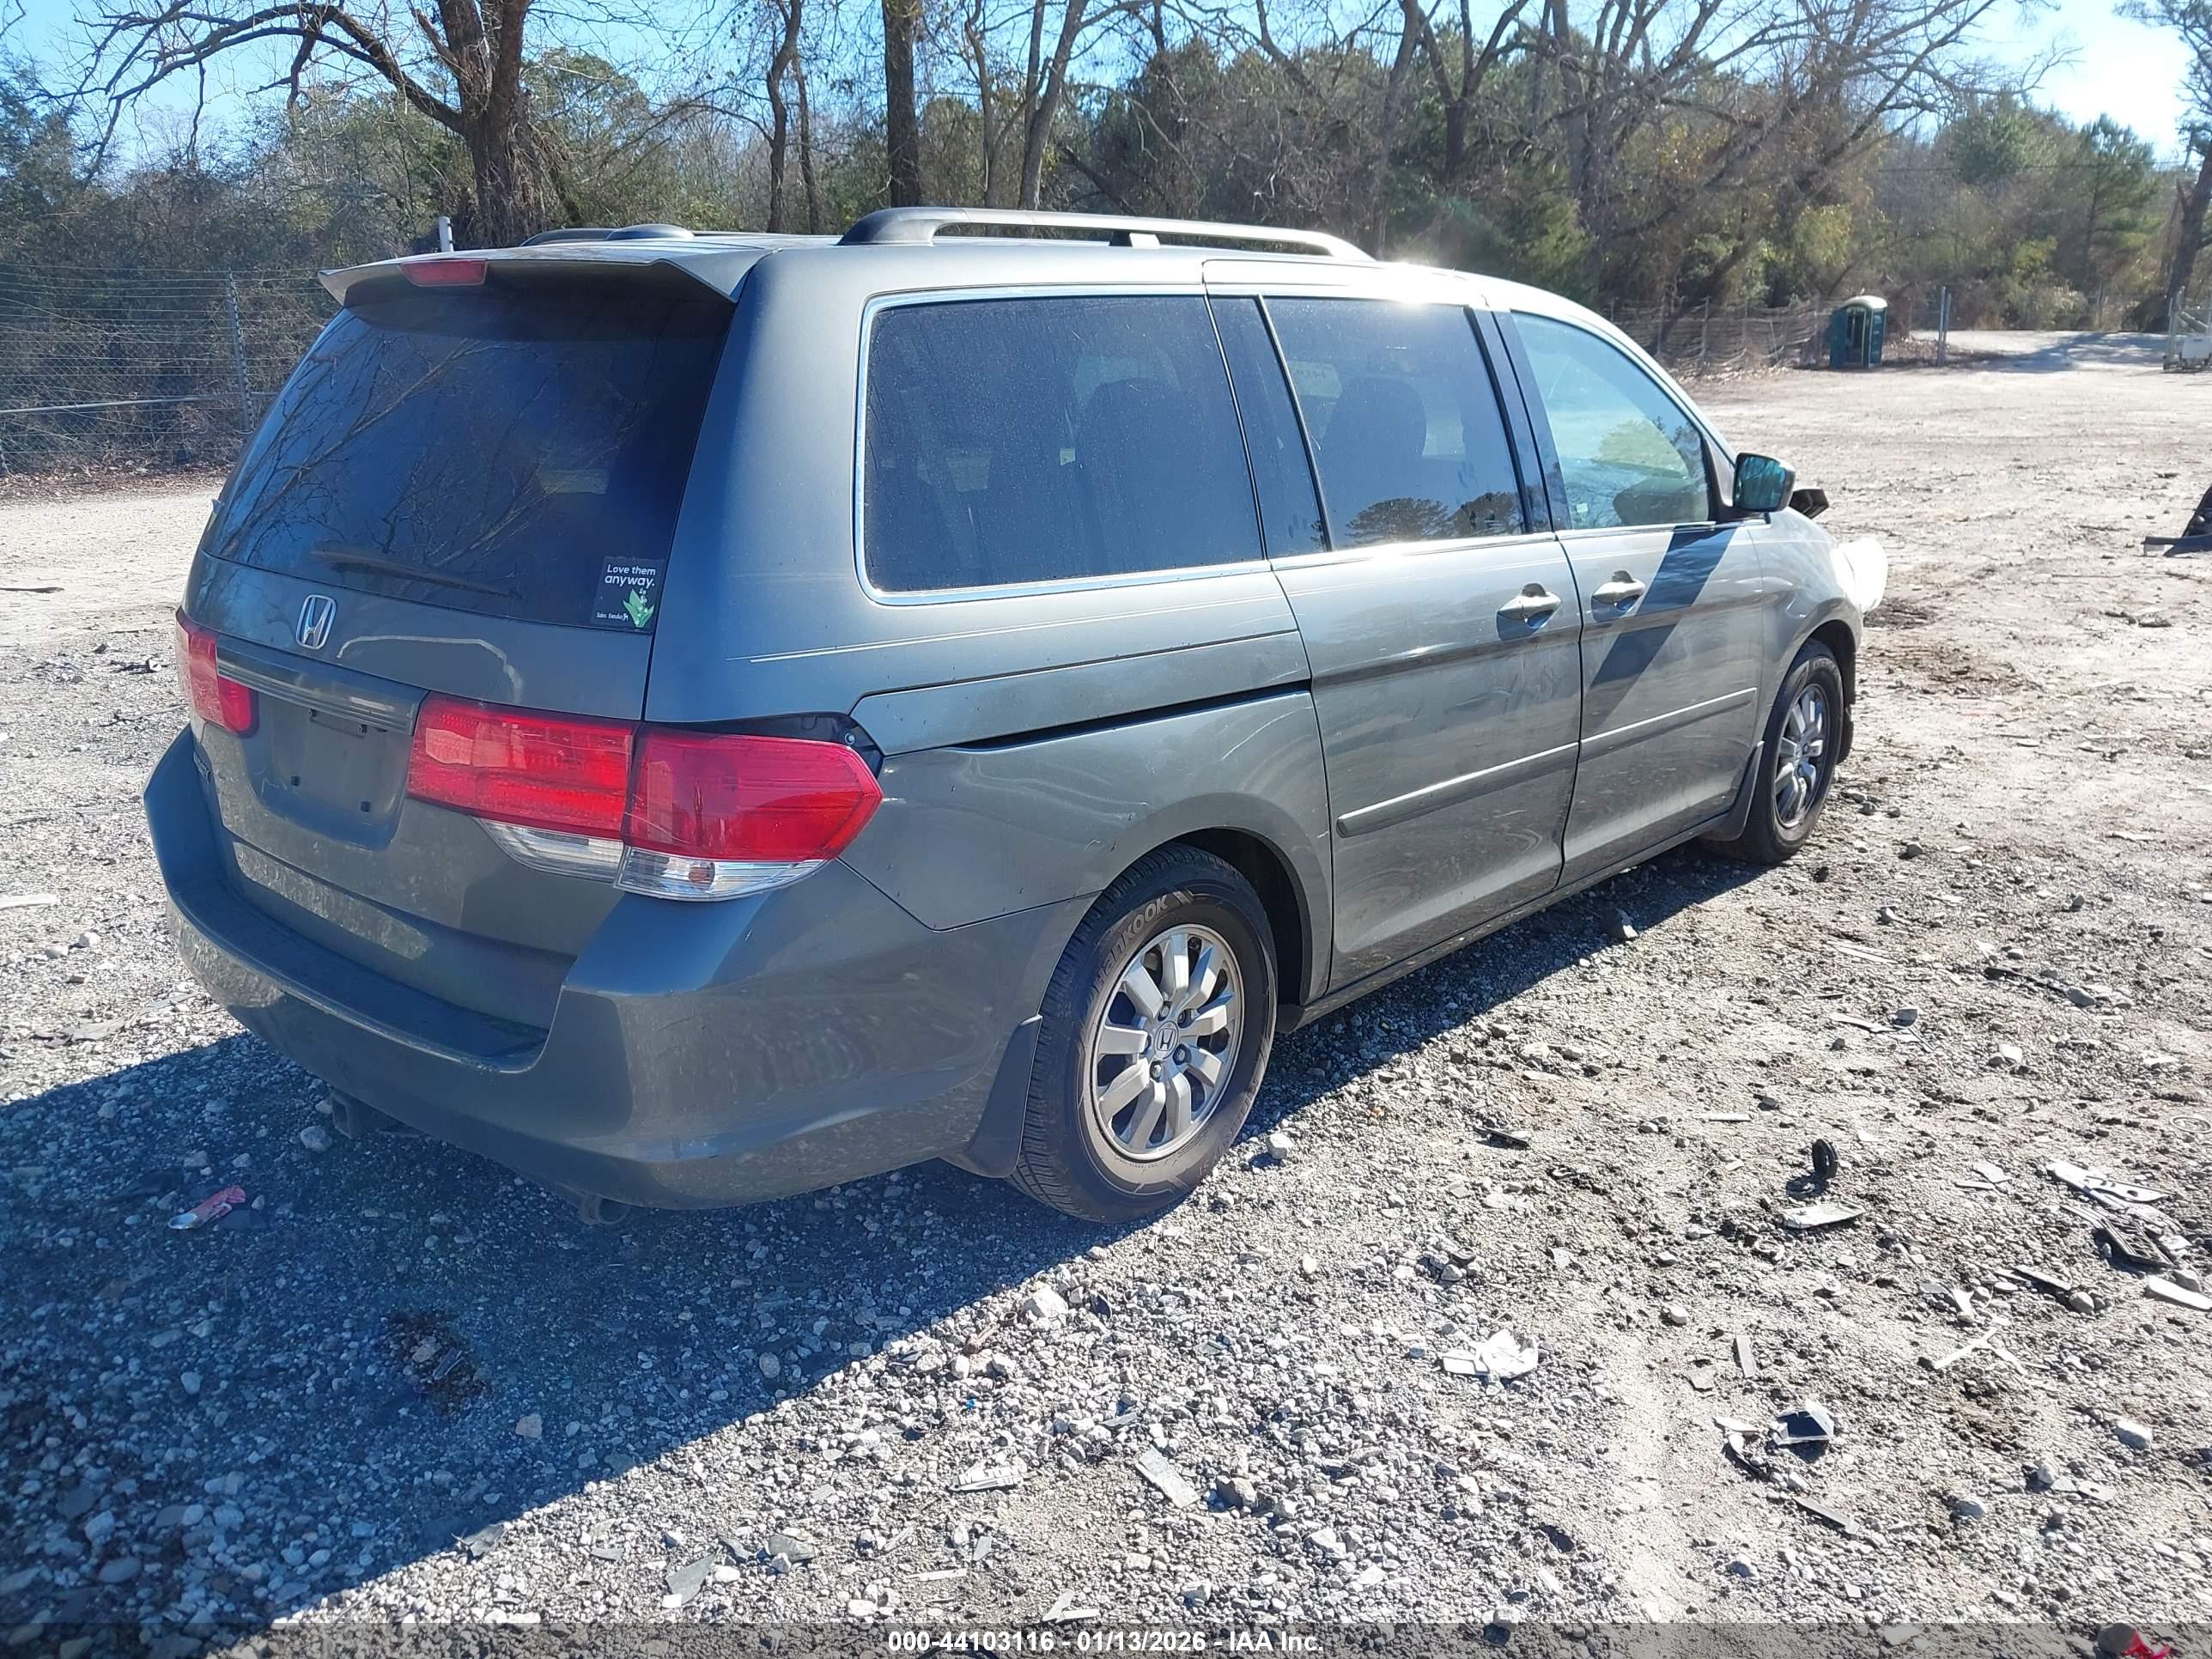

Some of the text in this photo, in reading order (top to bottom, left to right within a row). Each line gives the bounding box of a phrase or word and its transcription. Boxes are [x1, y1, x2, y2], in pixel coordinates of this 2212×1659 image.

[606, 563, 656, 576] Love them
[605, 574, 655, 589] anyway.
